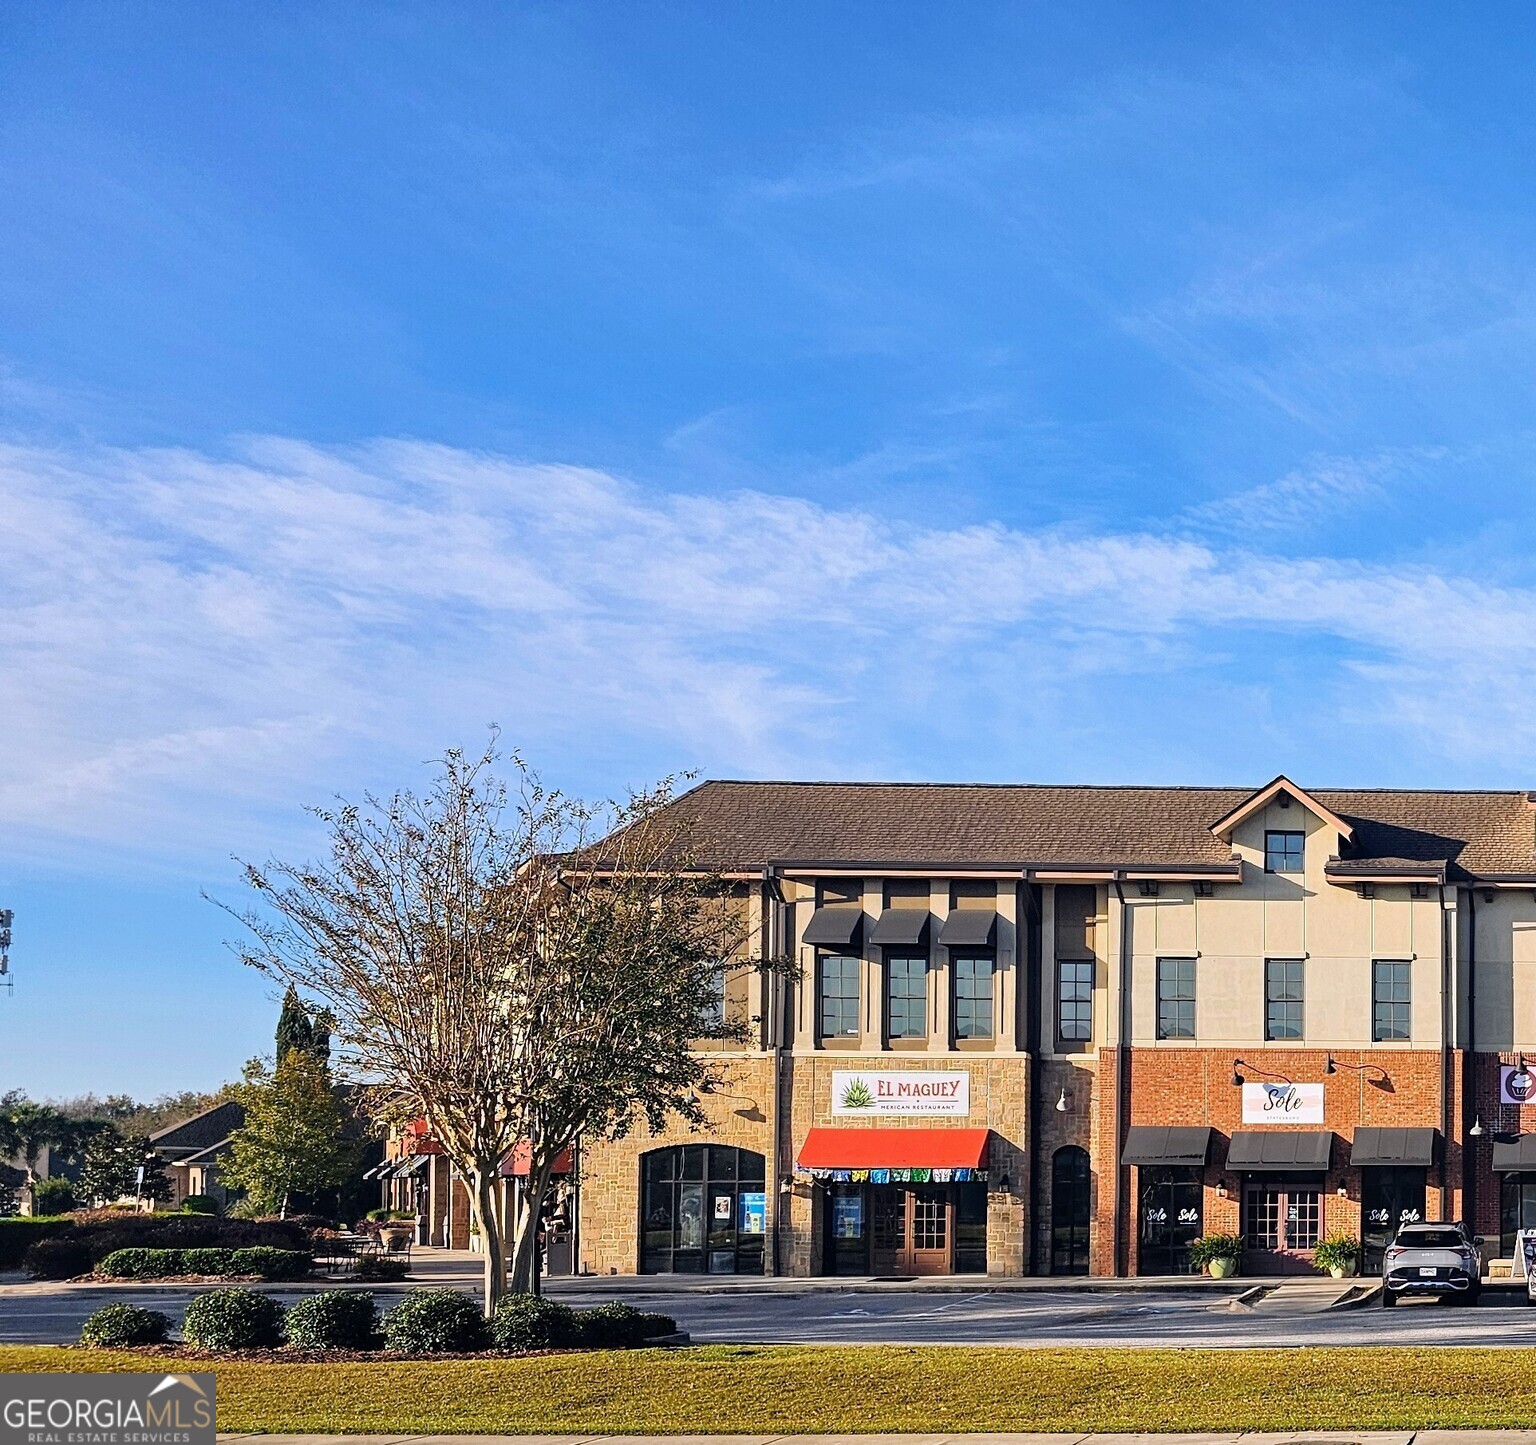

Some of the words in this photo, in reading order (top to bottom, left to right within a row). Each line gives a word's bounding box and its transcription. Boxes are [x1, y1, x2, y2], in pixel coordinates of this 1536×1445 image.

[877, 1079, 894, 1097] EL
[898, 1080, 961, 1097] MAGUEY
[1263, 1087, 1303, 1113] Sole
